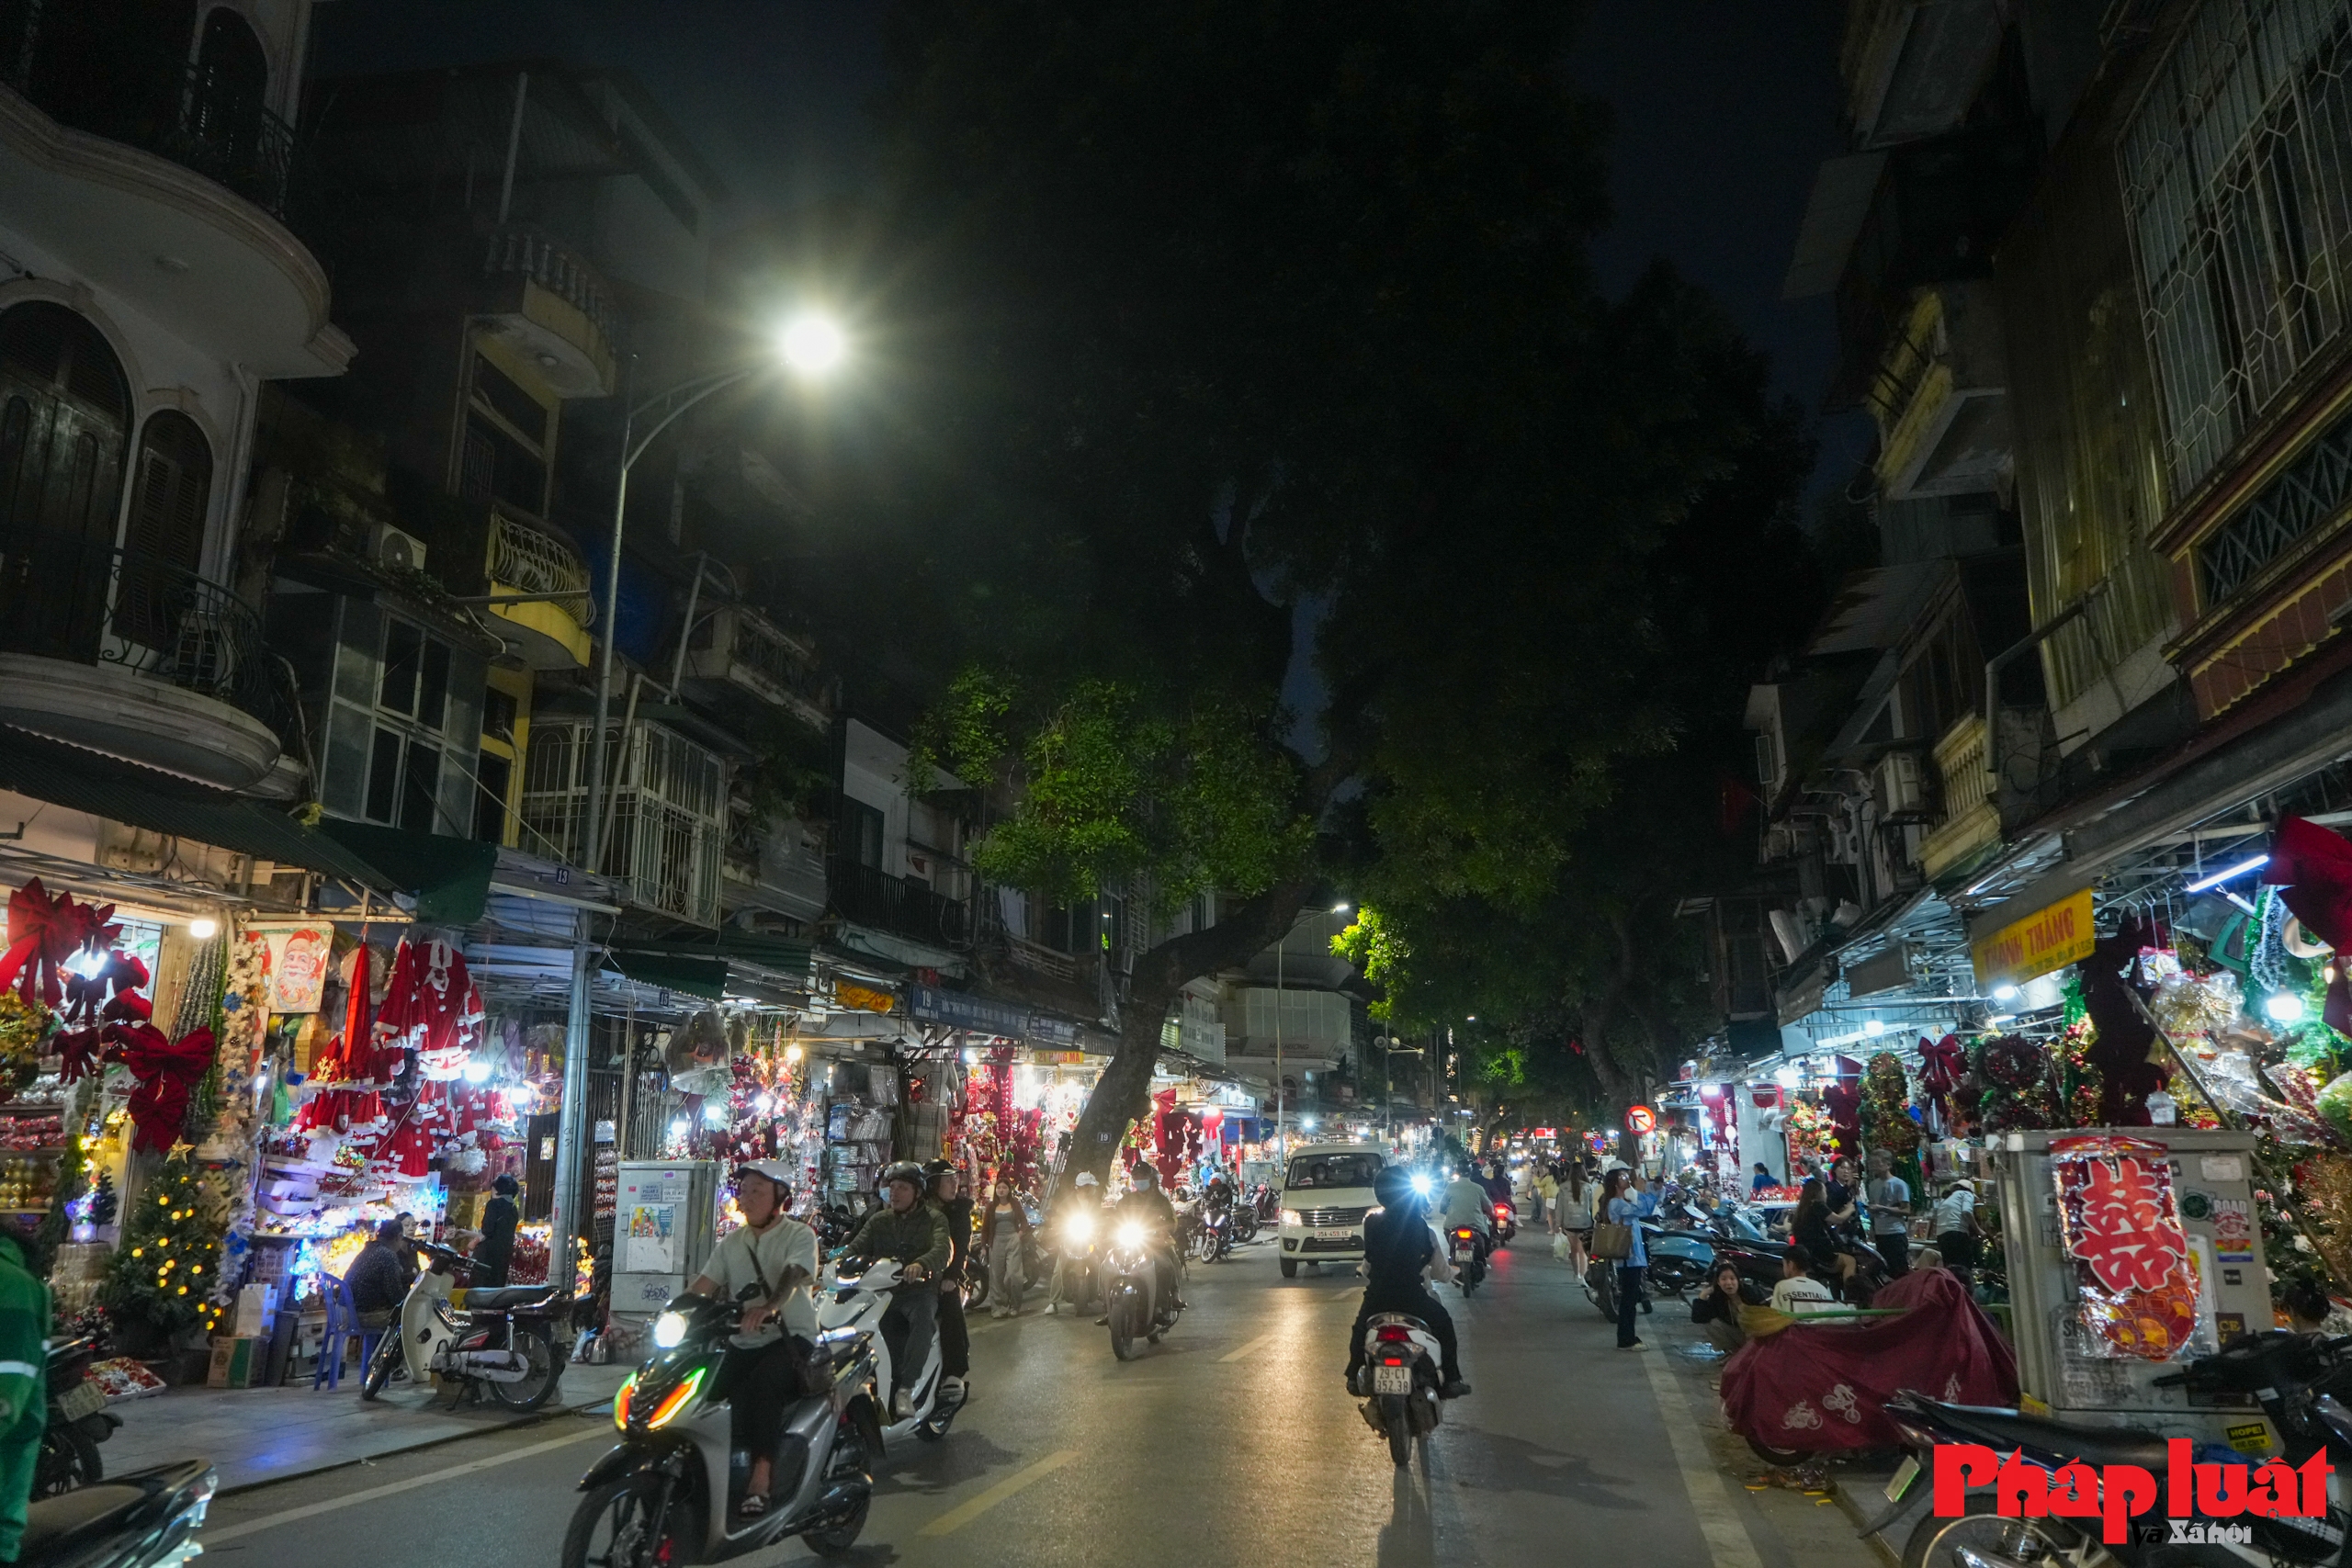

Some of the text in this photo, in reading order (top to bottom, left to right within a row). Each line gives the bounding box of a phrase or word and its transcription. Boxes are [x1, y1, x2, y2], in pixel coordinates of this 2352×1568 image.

[557, 869, 568, 884] 13
[660, 992, 669, 1005] 15
[922, 990, 932, 1007] 19
[1038, 1052, 1046, 1062] 21
[1100, 1134, 1109, 1142] 19
[2214, 1200, 2247, 1213] ROAD
[1376, 1381, 1408, 1393] 352.38
